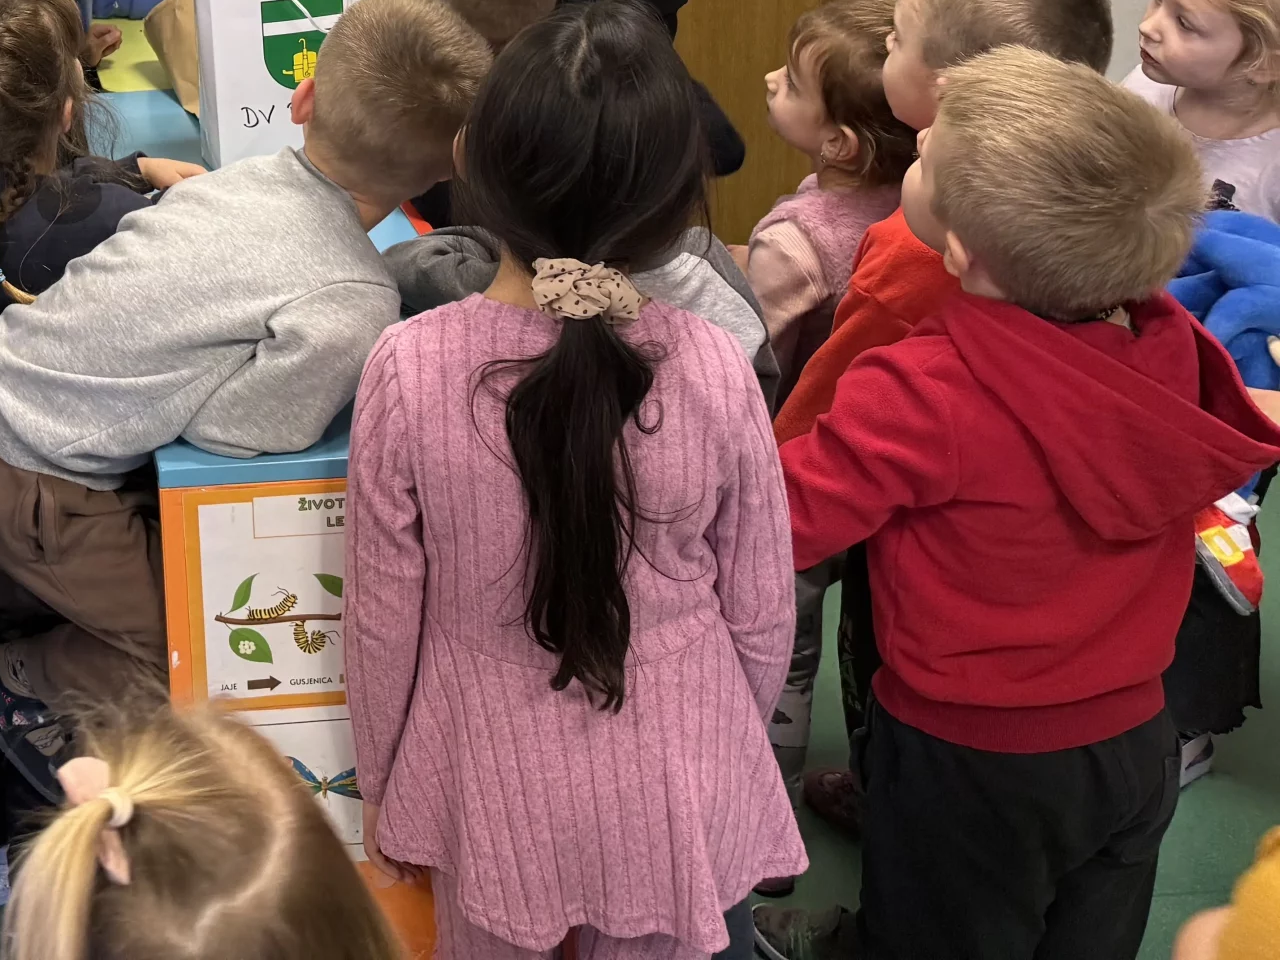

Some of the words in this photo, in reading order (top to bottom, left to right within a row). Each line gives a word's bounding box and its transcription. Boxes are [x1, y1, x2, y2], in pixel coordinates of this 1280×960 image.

[241, 105, 275, 128] DV
[298, 497, 345, 511] ŽIVOT
[221, 683, 237, 691] JAJE
[289, 677, 333, 686] GUSJENICA
